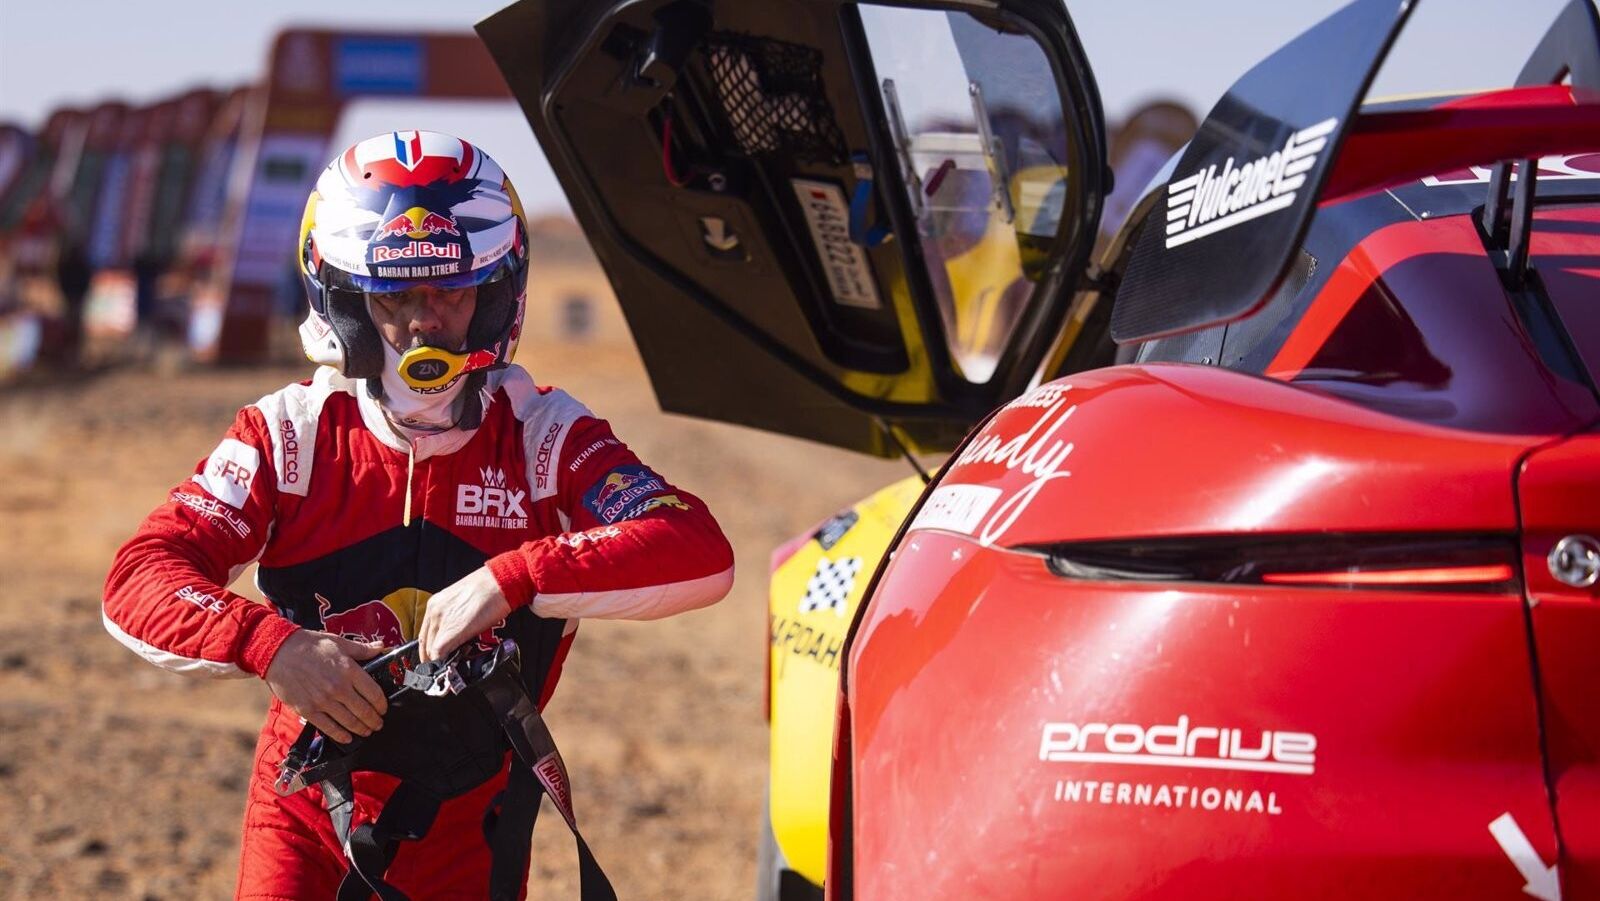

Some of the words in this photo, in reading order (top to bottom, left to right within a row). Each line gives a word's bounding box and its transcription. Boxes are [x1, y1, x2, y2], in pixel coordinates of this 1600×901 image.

[373, 242, 417, 263] Red
[417, 241, 461, 259] Bull
[377, 266, 410, 278] BAHRAIN
[411, 265, 430, 277] RAID
[431, 262, 460, 276] XTREME
[280, 418, 299, 485] sparco
[536, 422, 563, 490] sparco
[569, 439, 606, 473] RICHARD
[172, 491, 251, 539] prodrive
[456, 484, 527, 518] BRX
[602, 490, 636, 525] Red
[630, 479, 664, 499] Bull
[455, 515, 485, 527] BAHRAIN
[1038, 715, 1319, 775] prodrive
[1054, 780, 1283, 815] INTERNATIONAL
